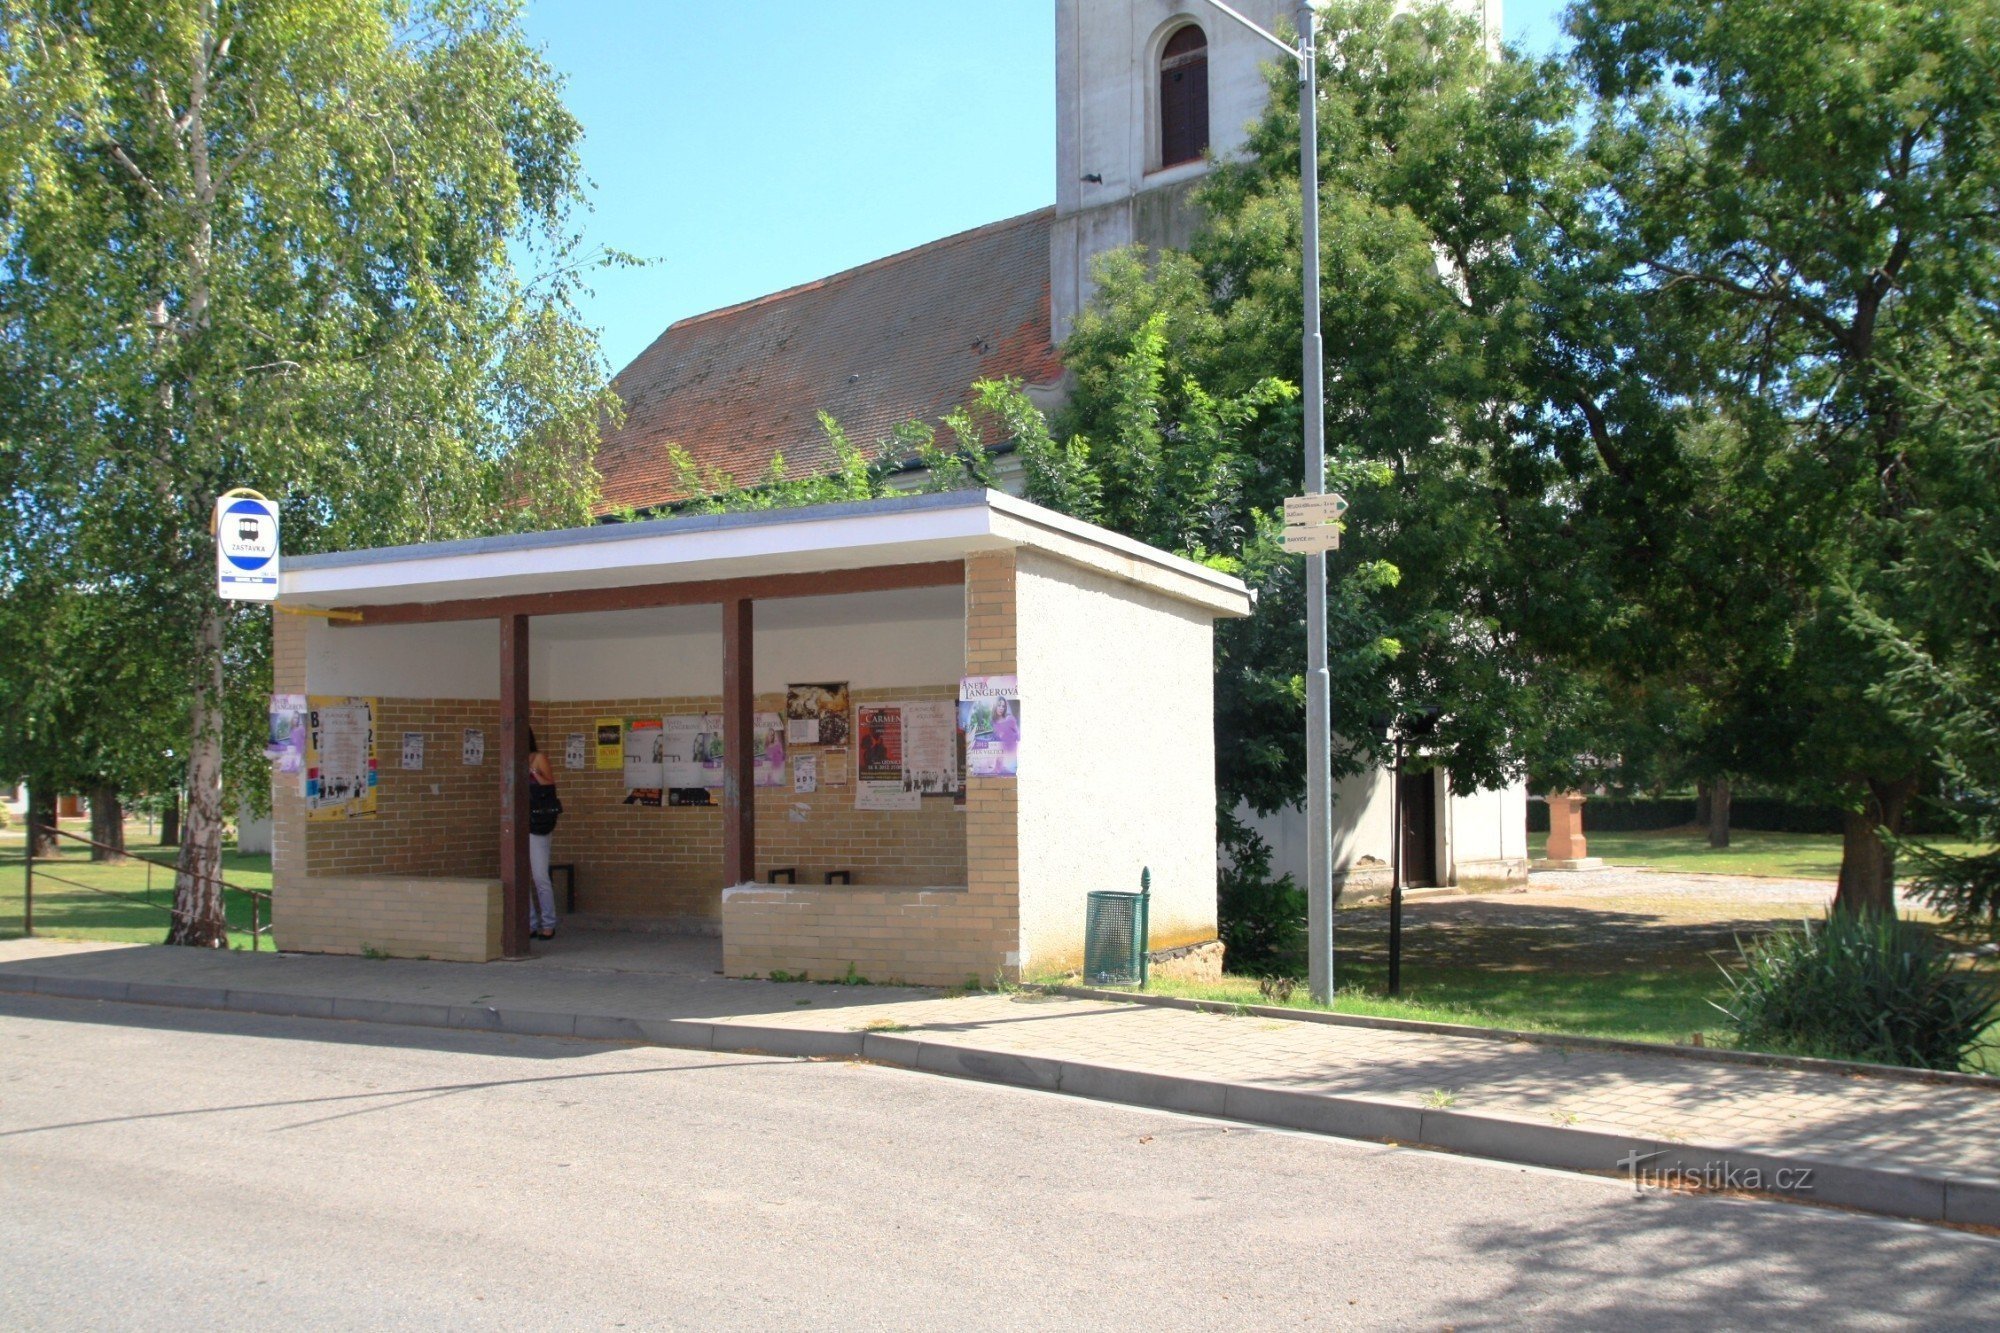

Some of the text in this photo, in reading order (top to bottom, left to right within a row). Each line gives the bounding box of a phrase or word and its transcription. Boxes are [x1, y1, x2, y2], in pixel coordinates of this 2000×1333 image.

[961, 680, 988, 690] ANETA
[964, 686, 1019, 700] LANGEROVÁ
[865, 713, 902, 723] CARMEN
